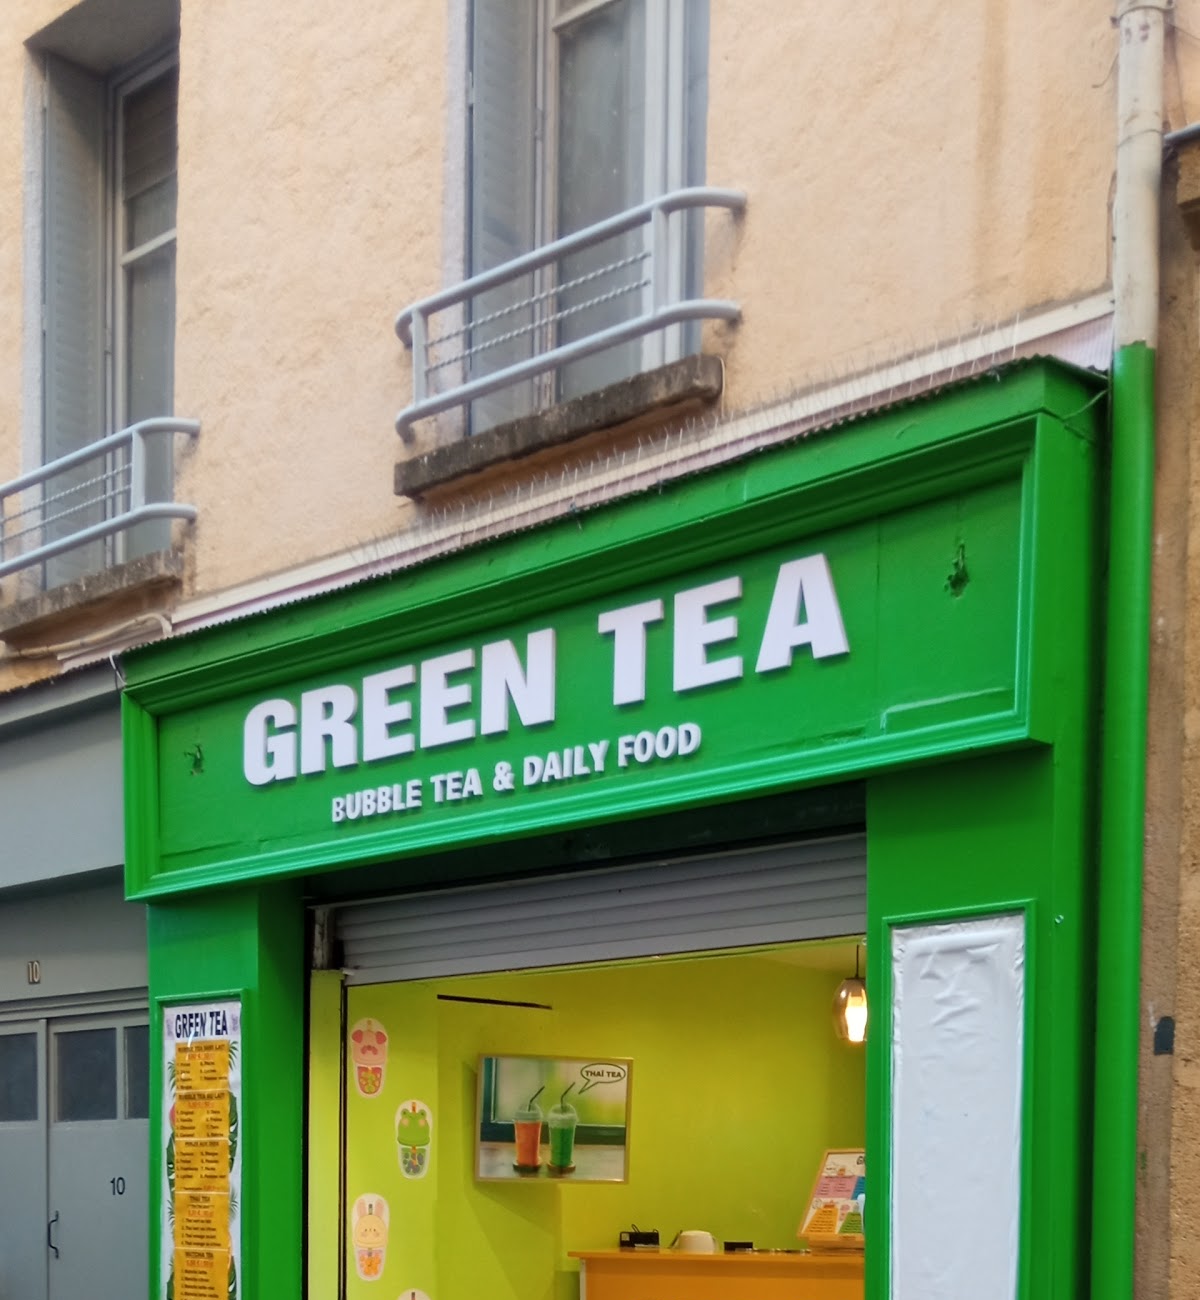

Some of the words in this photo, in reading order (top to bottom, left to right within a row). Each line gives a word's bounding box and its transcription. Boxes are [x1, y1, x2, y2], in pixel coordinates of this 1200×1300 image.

[243, 627, 556, 787] GREEN
[598, 552, 850, 707] TEA
[332, 779, 422, 822] BUBBLE
[430, 768, 483, 803] TEA
[493, 761, 515, 791] &
[523, 740, 609, 786] DAILY
[617, 722, 702, 767] FOOD
[28, 961, 40, 983] 10
[175, 1012, 207, 1038] GREEN
[209, 1010, 228, 1035] TEA
[110, 1177, 126, 1195] 10
